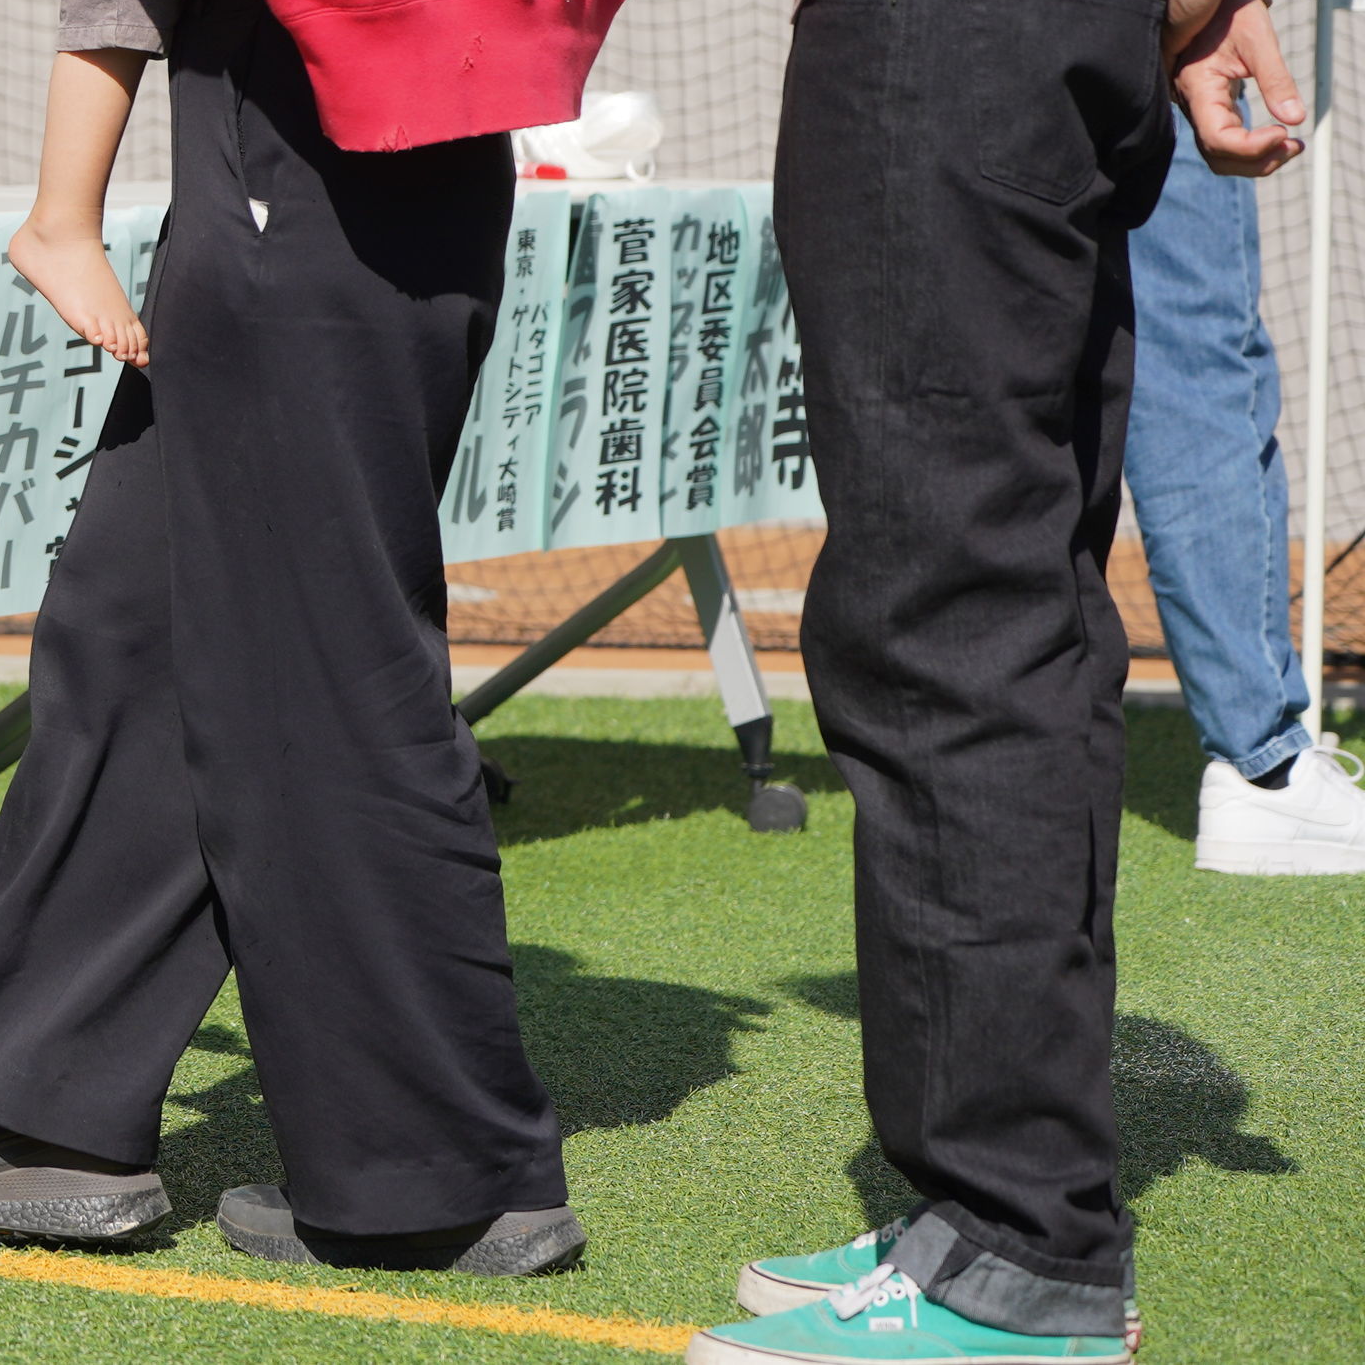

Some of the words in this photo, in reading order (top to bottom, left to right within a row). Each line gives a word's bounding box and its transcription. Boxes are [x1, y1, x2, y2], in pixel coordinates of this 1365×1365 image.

[496, 228, 538, 532] 東京・ゲートシティ大崎賞
[524, 300, 552, 426] パタゴニア
[595, 217, 657, 516] 菅家医院歯科
[685, 219, 741, 512] 地区委員会賞
